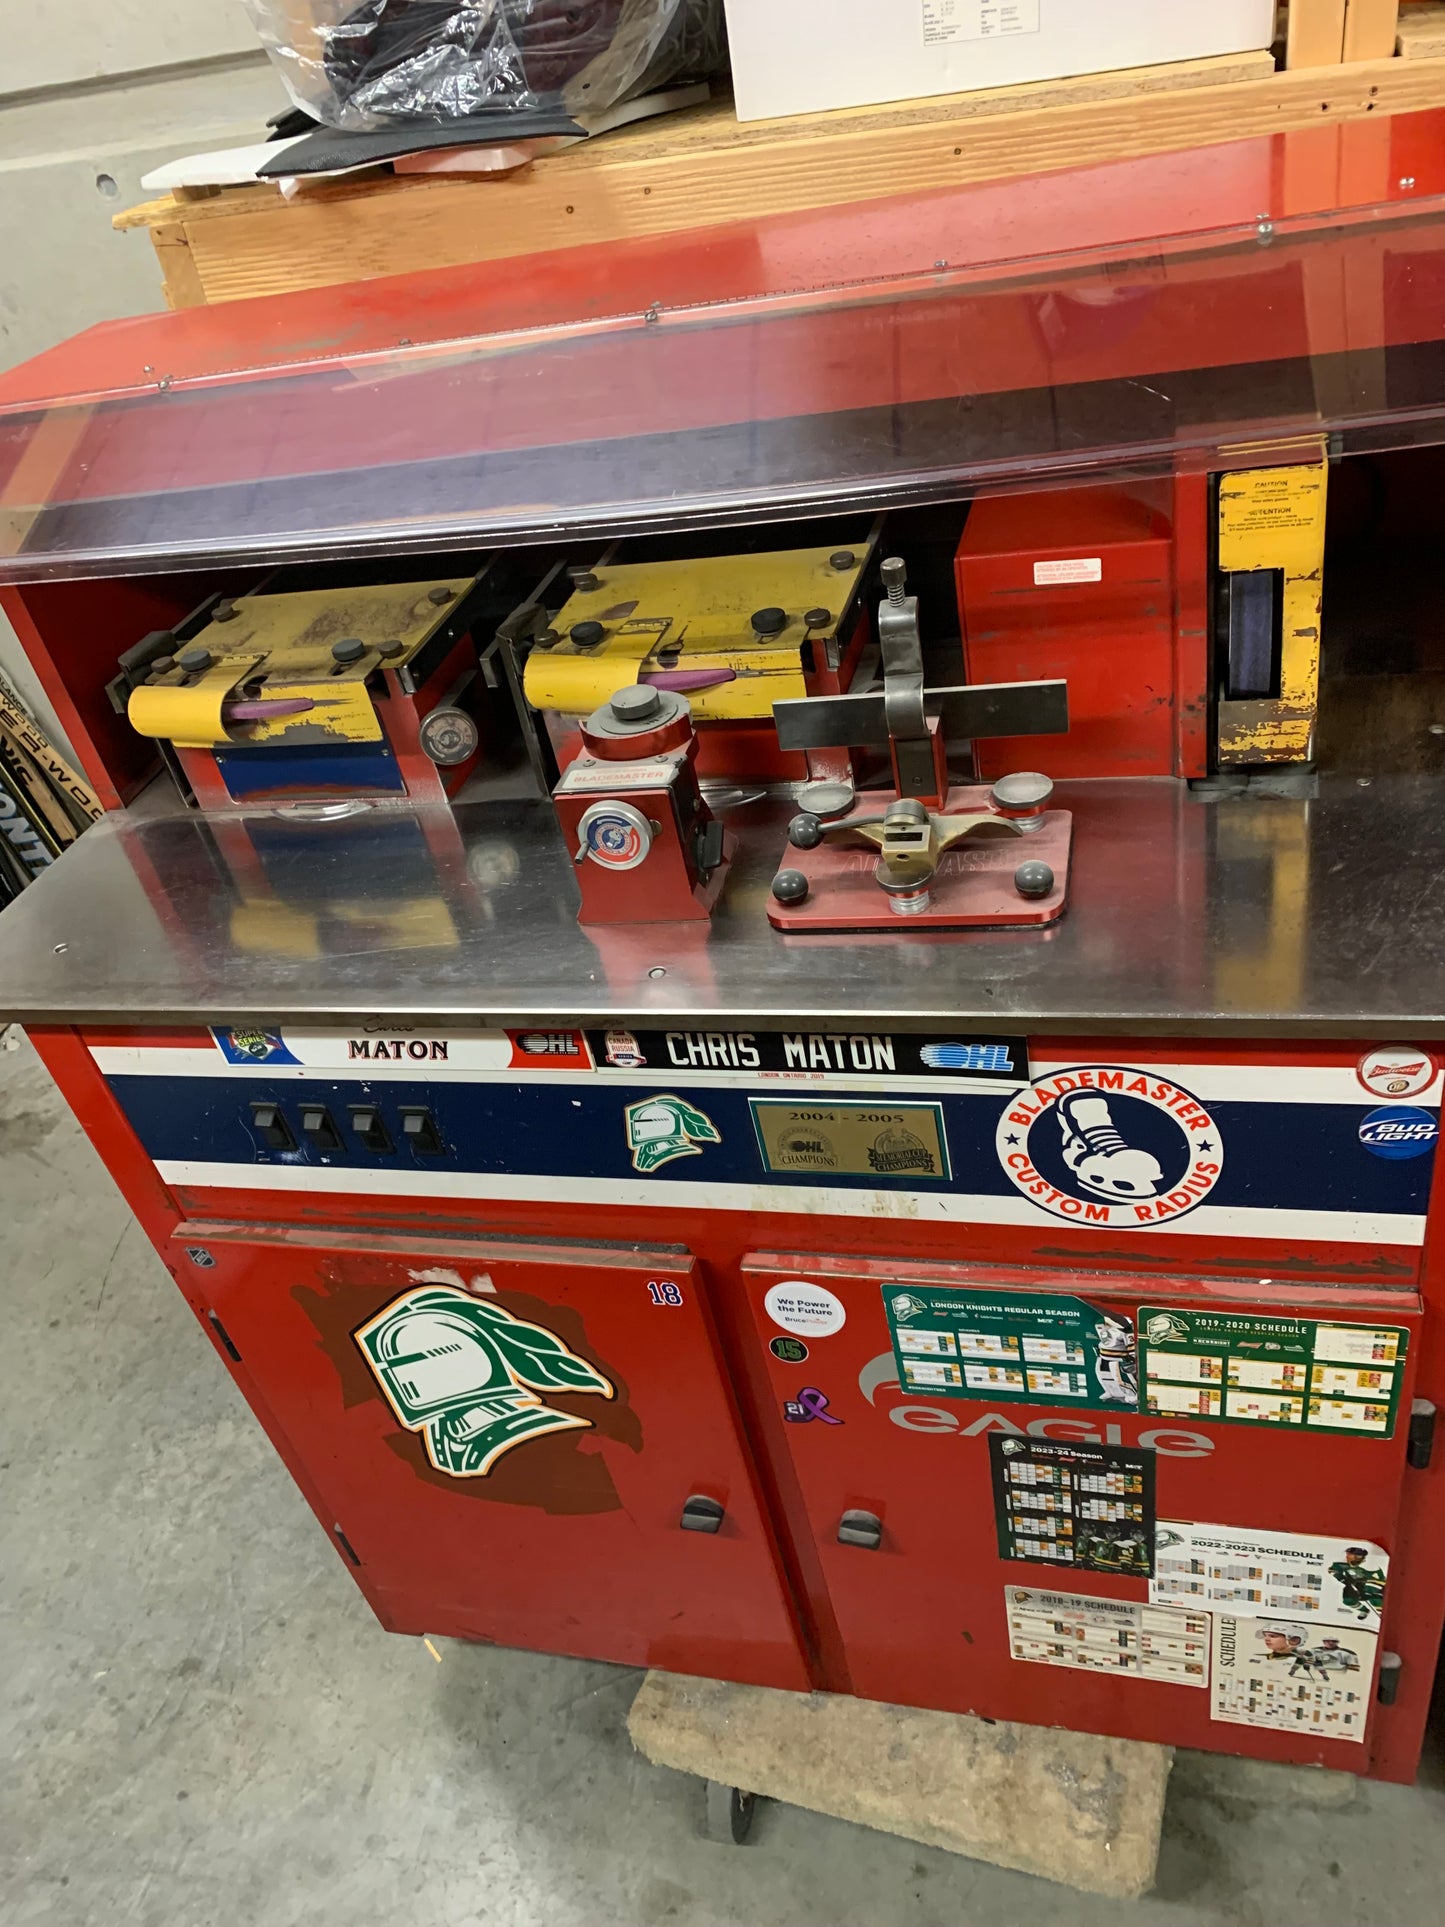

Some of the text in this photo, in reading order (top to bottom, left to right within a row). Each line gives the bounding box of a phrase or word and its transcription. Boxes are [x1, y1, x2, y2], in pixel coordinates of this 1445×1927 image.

[516, 1033, 579, 1055] OHL
[608, 1037, 634, 1045] CANADA
[347, 1040, 448, 1061] MATON
[665, 1033, 897, 1071] CHRIS MATON
[920, 1042, 1015, 1072] OHL
[1008, 1071, 1211, 1132] BLADEMASTER
[789, 1112, 835, 1121] 2004
[856, 1113, 905, 1123] 2005
[1376, 1123, 1436, 1133] BUD
[1361, 1132, 1440, 1141] LIGHT
[788, 1140, 824, 1154] OHL
[782, 1155, 835, 1167] CHAMPIONS
[878, 1159, 929, 1171] CHAMPIONS
[1007, 1153, 1110, 1221] CUSTOM
[1133, 1161, 1219, 1221] RADIUS
[647, 1281, 683, 1306] 18
[777, 1298, 831, 1309] We Power
[777, 1305, 833, 1316] the Future
[930, 1302, 1080, 1317] LONDON KNIGHTS REGULAR SEASON
[1195, 1318, 1308, 1335] 2019-2020 SCHEDULE
[775, 1340, 802, 1360] 15
[1031, 1446, 1069, 1456] 2023-24
[1070, 1451, 1104, 1460] Season
[1191, 1539, 1324, 1560] 2022-2023 SCHEDULE
[1084, 1600, 1136, 1614] SCHEDULE
[1220, 1617, 1237, 1668] SCHEDULE
